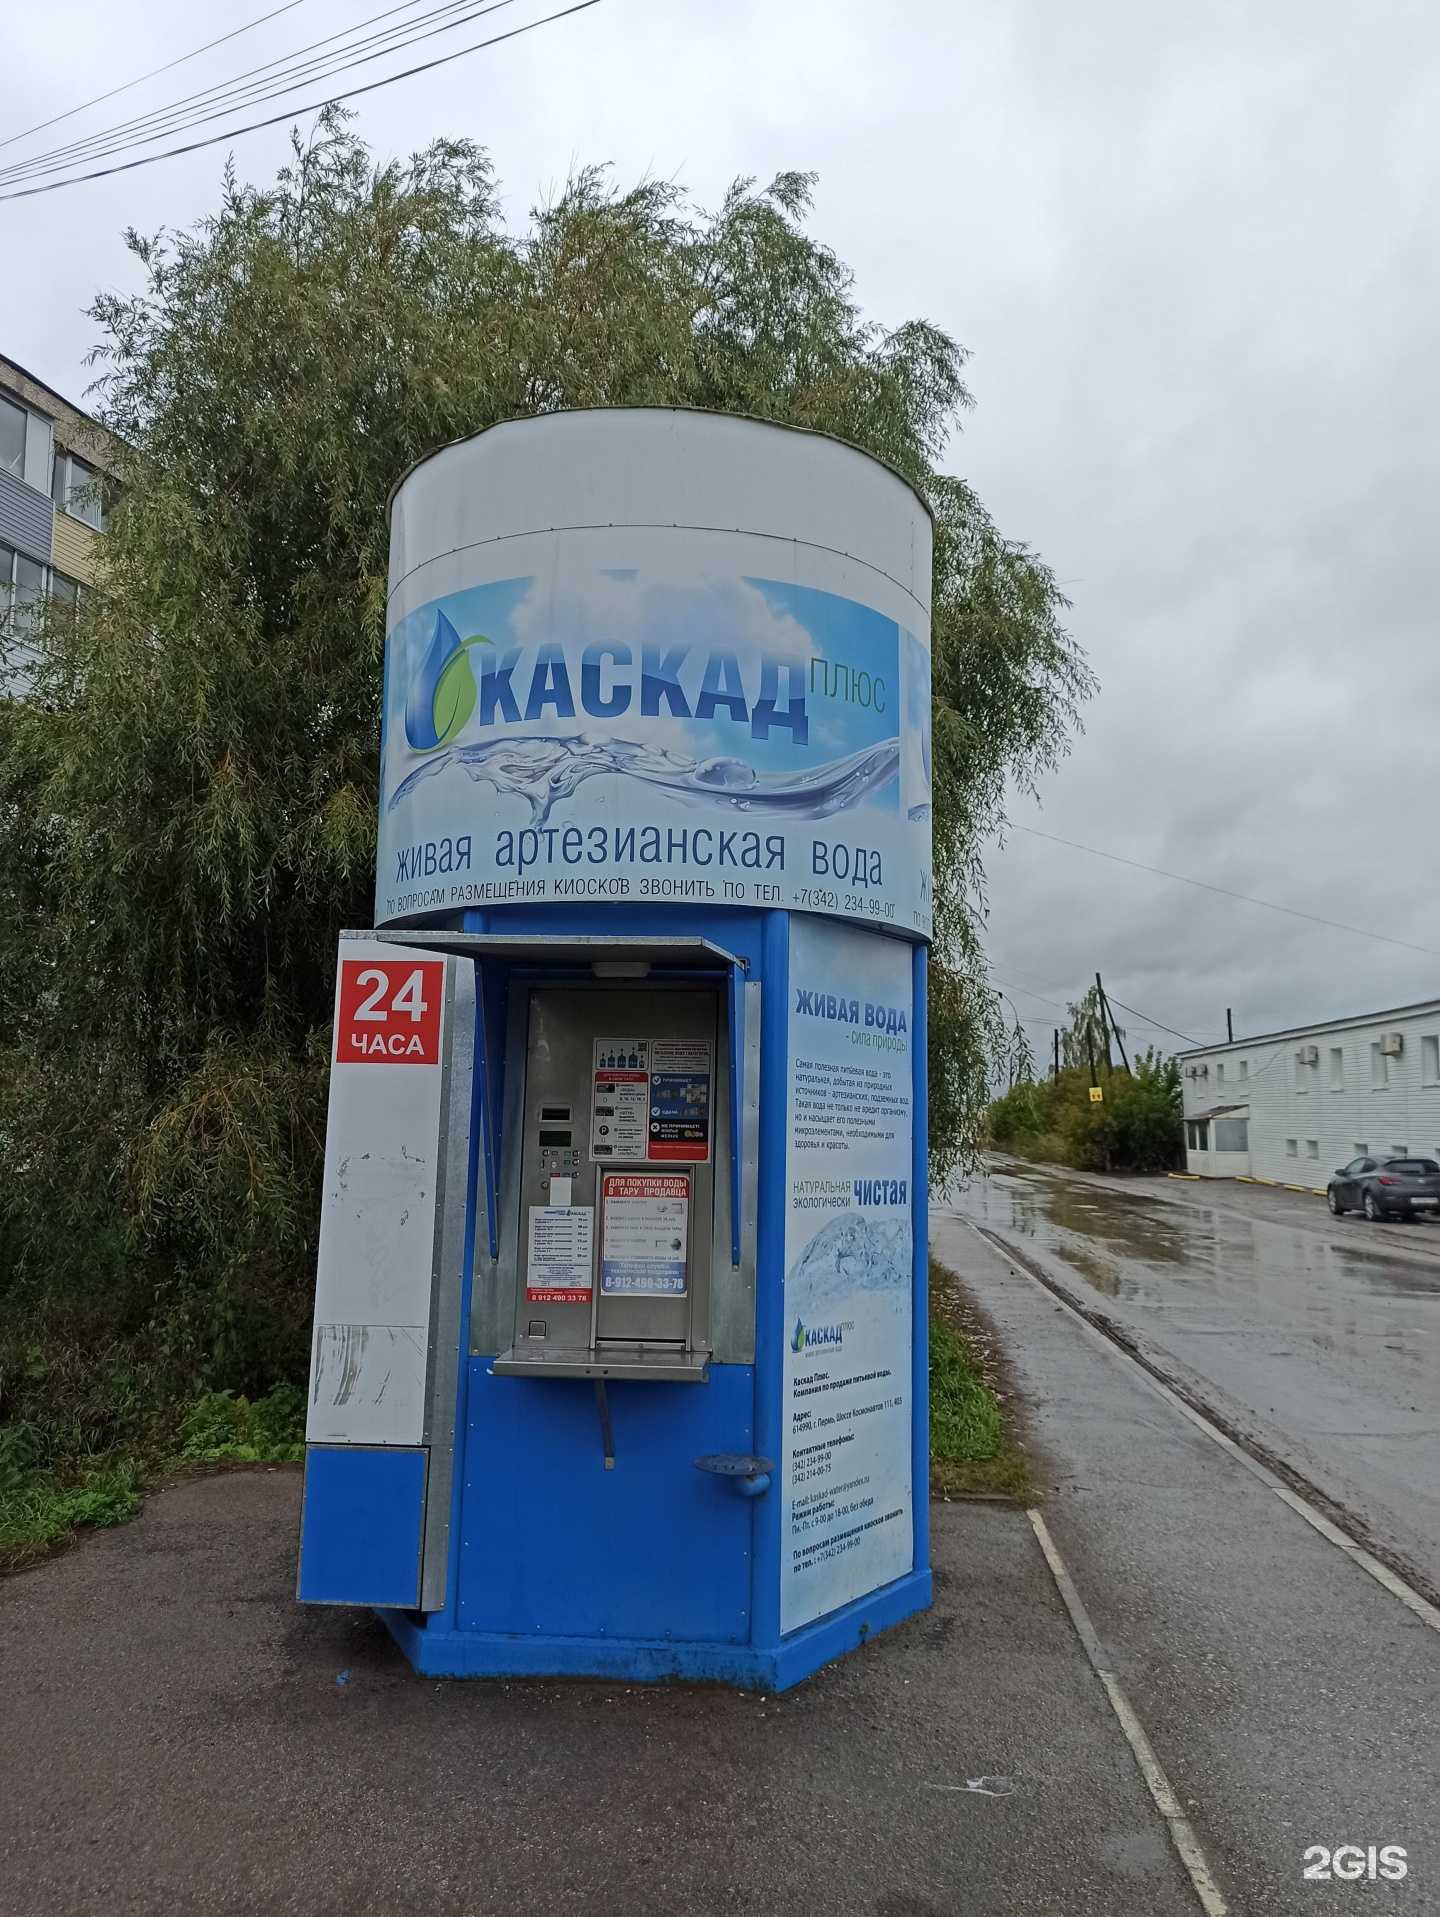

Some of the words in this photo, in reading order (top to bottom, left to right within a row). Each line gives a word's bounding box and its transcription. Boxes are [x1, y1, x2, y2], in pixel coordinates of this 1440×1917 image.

[480, 638, 808, 745] КАСКАД
[810, 657, 887, 714] ПЛЮС
[396, 834, 472, 884] живая
[495, 825, 786, 876] артезианская
[812, 839, 883, 888] вода
[397, 889, 445, 911] ВОПРОСАМ
[450, 879, 546, 901] РАЗМЕЩЕНИЯ
[554, 877, 630, 895] КИОСКОВ
[639, 878, 715, 897] ЗВОНИТЬ
[723, 882, 745, 899] ПО
[753, 883, 785, 902] ТЕЛ.
[792, 888, 839, 908] +7(342)
[844, 894, 895, 918] 234-99-00
[353, 969, 428, 1022] 24
[795, 988, 859, 1024] ЖИВАЯ
[864, 1003, 907, 1035] ВОДА
[351, 1033, 425, 1056] ЧАСА
[851, 1030, 871, 1047] сила
[873, 1033, 908, 1053] природы
[795, 1058, 813, 1069] Самая
[814, 1063, 839, 1073] полезная
[840, 1066, 864, 1076] питьевая
[865, 1069, 878, 1078] вода
[882, 1071, 891, 1079] это
[795, 1074, 831, 1086] натуральная,
[832, 1077, 855, 1087] добытая
[856, 1080, 863, 1088] из
[864, 1081, 892, 1091] природных
[795, 1087, 827, 1097] источников
[832, 1091, 870, 1102] артезианских,
[870, 1094, 899, 1104] подземных
[795, 1098, 811, 1109] Такая
[812, 1102, 826, 1110] вода
[835, 1104, 853, 1112] только
[854, 1105, 861, 1113] не
[861, 1106, 880, 1114] вредит
[808, 1115, 835, 1123] насыщает
[847, 1118, 875, 1126] полезными
[794, 1128, 844, 1139] микроэлементами,
[846, 1129, 884, 1138] необходимыми
[794, 1140, 819, 1150] здоровья
[608, 1178, 625, 1187] ДЛЯ
[627, 1178, 662, 1187] ПОКУПКИ
[664, 1179, 687, 1188] ВОДЫ
[608, 1187, 614, 1195] В
[619, 1187, 639, 1196] ТАРУ
[644, 1188, 687, 1197] ПРОДАВЦА
[793, 1180, 851, 1193] НАТУРАЛЬНАЯ
[805, 1327, 842, 1347] КАСКАД
[793, 1376, 813, 1387] Каскад
[793, 1386, 822, 1398] Компания
[830, 1378, 852, 1391] продаже
[852, 1370, 876, 1383] питьевой
[793, 1411, 812, 1422] Адрес:
[836, 1410, 852, 1422] Шоссе
[852, 1403, 883, 1417] Космонавтов
[792, 1442, 826, 1459] Контактные
[827, 1433, 855, 1448] телефоны:
[792, 1460, 805, 1472] (342)
[806, 1451, 831, 1466] 234-99-00
[792, 1472, 805, 1486] (342)
[806, 1463, 831, 1479] 214-00-75
[792, 1510, 811, 1522] Режим
[812, 1500, 835, 1516] работы:
[859, 1496, 874, 1509] обеда
[793, 1550, 802, 1560] По
[802, 1540, 830, 1557] вопросам
[830, 1525, 864, 1546] размещения
[793, 1565, 801, 1574] по
[836, 1535, 861, 1554] 234-99-00
